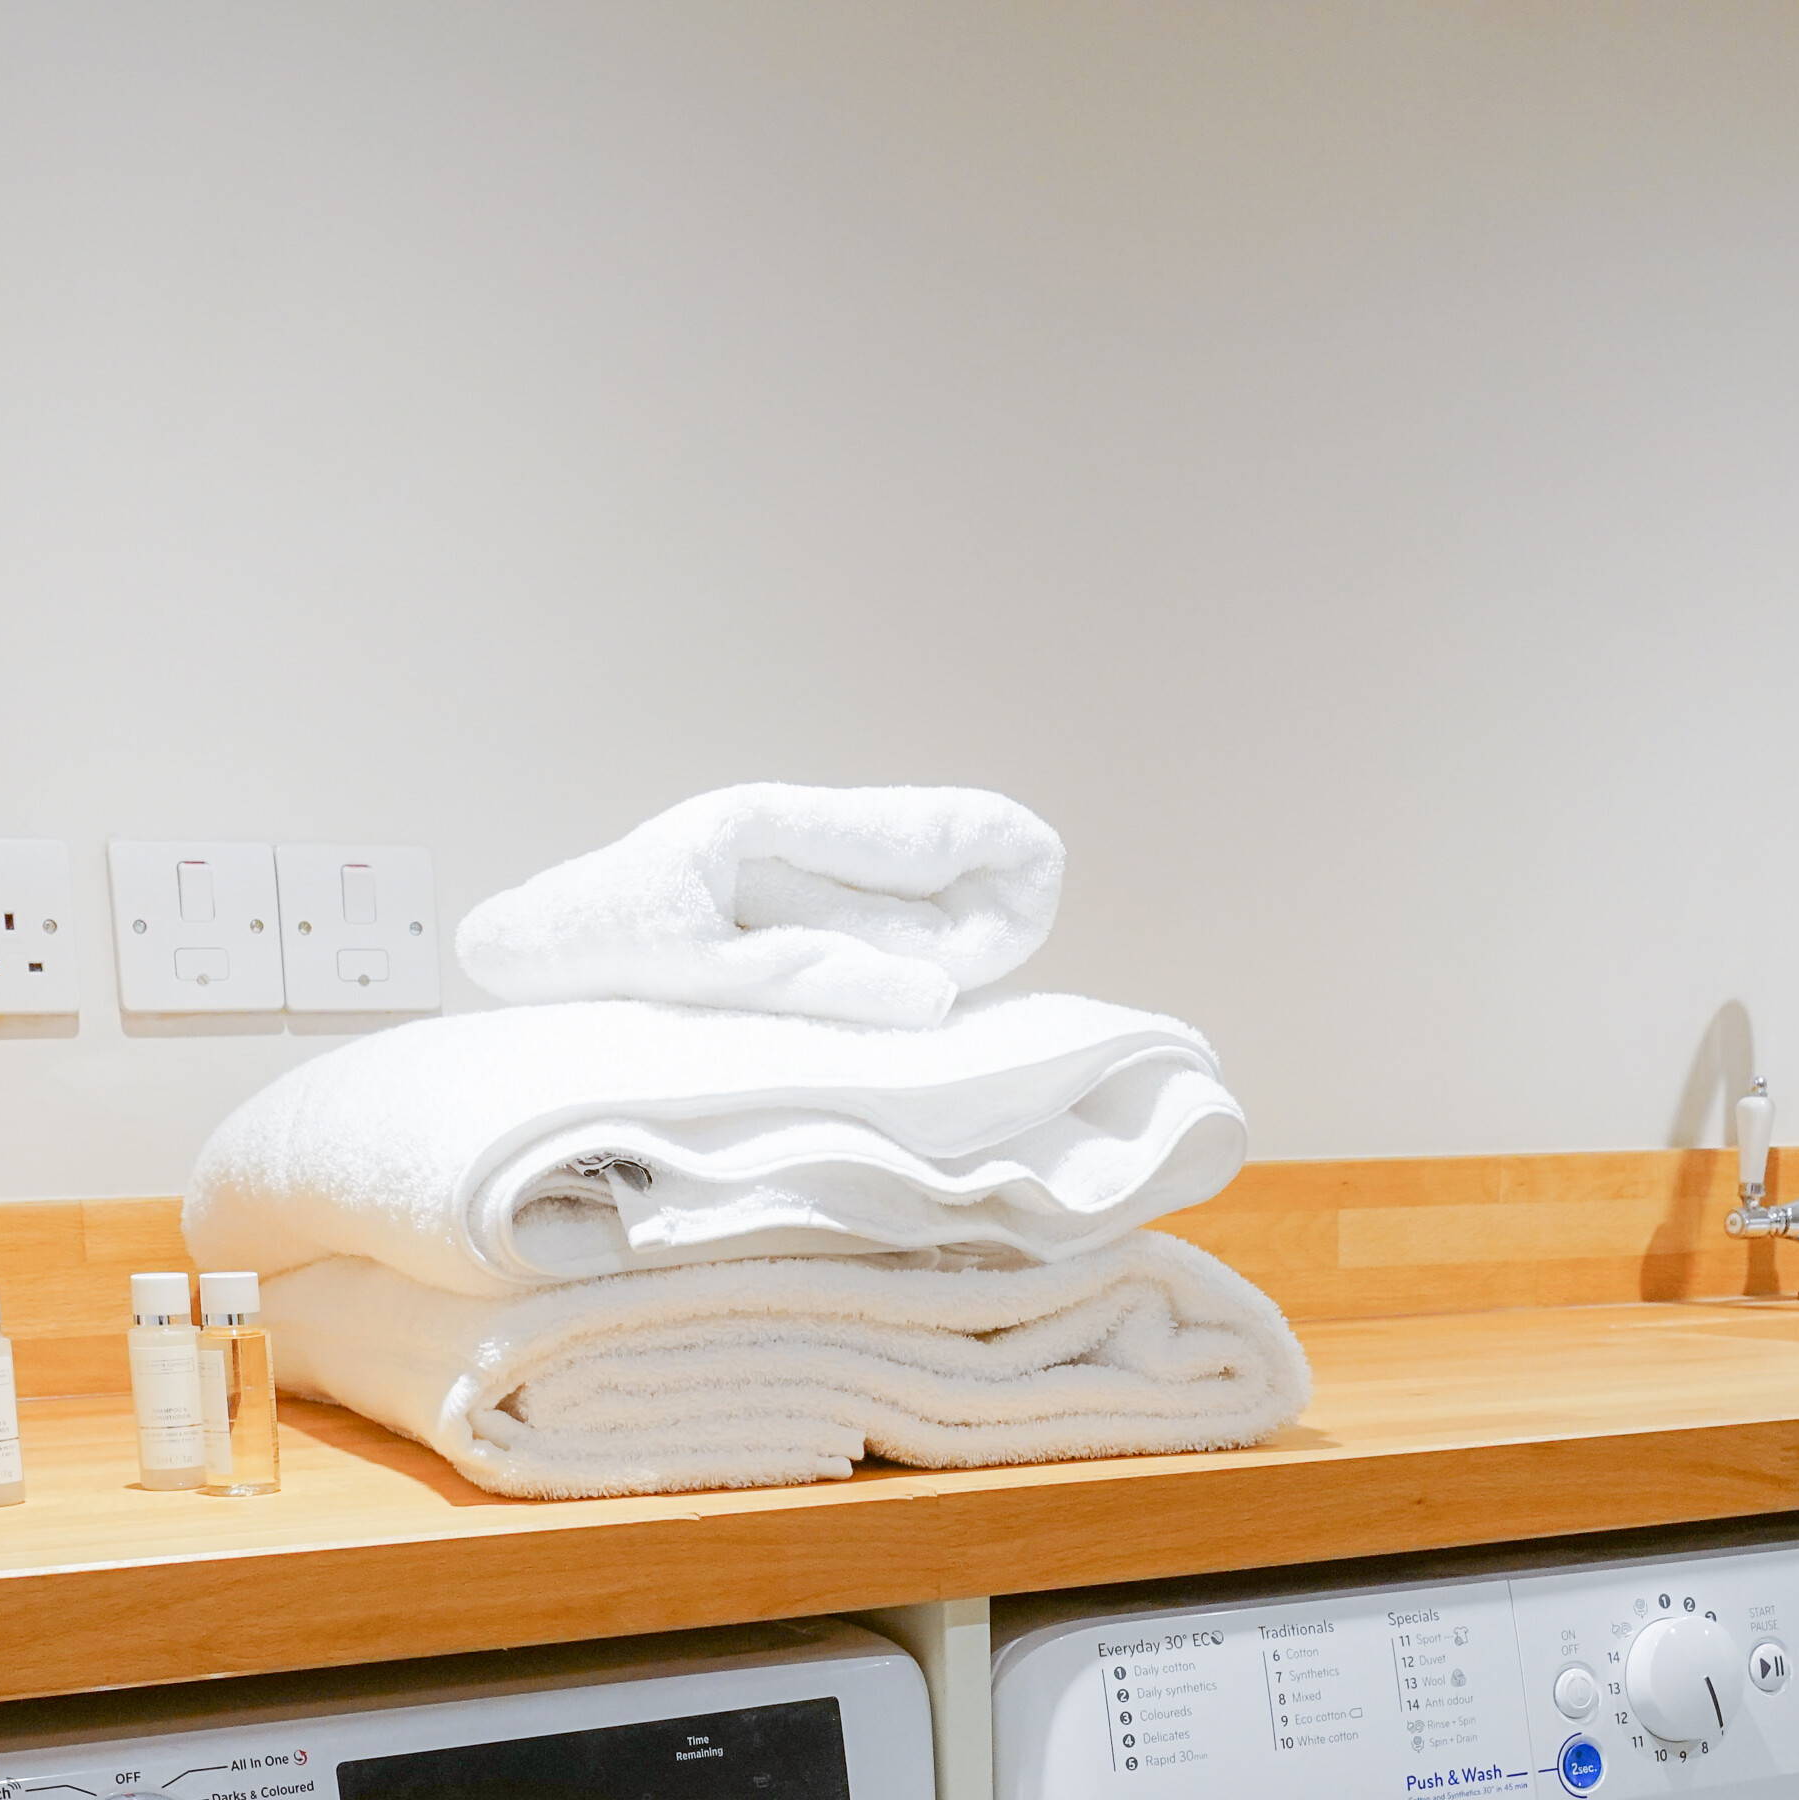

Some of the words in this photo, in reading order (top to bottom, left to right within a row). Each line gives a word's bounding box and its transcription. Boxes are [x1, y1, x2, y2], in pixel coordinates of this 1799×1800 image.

[1387, 1608, 1440, 1628] Specials
[1748, 1605, 1776, 1618] START
[1257, 1619, 1335, 1640] Traditionals
[1750, 1619, 1778, 1632] PAUSE
[1399, 1634, 1411, 1647] 11
[1416, 1632, 1442, 1646] Sport
[1561, 1629, 1576, 1641] ON
[1097, 1638, 1161, 1658] Everyday
[1164, 1633, 1187, 1651] 30°
[1561, 1643, 1580, 1656] OFF
[1272, 1649, 1280, 1662] 6
[1286, 1647, 1320, 1660] Cotton
[1401, 1655, 1415, 1669] 12
[1419, 1653, 1447, 1666] Duvet
[1607, 1651, 1621, 1664] 14
[1134, 1664, 1160, 1677] Daily
[1162, 1661, 1196, 1674] cotton
[1275, 1671, 1283, 1683] 7
[1289, 1667, 1340, 1683] Synthetics
[1404, 1677, 1418, 1690] 13
[1421, 1675, 1446, 1687] Wool
[1607, 1682, 1621, 1696] 13
[1137, 1686, 1162, 1700] Daily
[1165, 1682, 1218, 1697] synthetics
[1278, 1693, 1286, 1705] 8
[1292, 1690, 1322, 1703] Mixed
[1406, 1698, 1420, 1711] 14
[1425, 1697, 1444, 1709] Anti
[1447, 1694, 1474, 1706] odour
[1139, 1705, 1193, 1722] Coloureds
[1281, 1715, 1289, 1728] 9
[1294, 1713, 1313, 1725] Eco
[1315, 1711, 1347, 1723] cotton
[1615, 1711, 1629, 1725] 12
[1427, 1719, 1451, 1730] Rinse
[1457, 1716, 1477, 1728] Spin
[686, 1735, 710, 1747] Time
[1142, 1730, 1191, 1745] Delicates
[1280, 1736, 1294, 1750] 10
[1296, 1734, 1326, 1747] White
[1328, 1731, 1359, 1744] cotton
[1429, 1737, 1448, 1749] Spin
[1456, 1733, 1478, 1744] Drain
[1632, 1735, 1644, 1748] 11
[675, 1746, 724, 1761] Remaining
[1701, 1741, 1709, 1754] 8
[1145, 1753, 1176, 1768] Rapid
[1654, 1749, 1668, 1762] 10
[1679, 1750, 1687, 1763] 9
[231, 1758, 247, 1772] All
[250, 1758, 262, 1769] In
[264, 1755, 289, 1767] One
[115, 1771, 142, 1785] OFF
[1406, 1772, 1444, 1791] Push
[1447, 1769, 1461, 1786] &
[1461, 1763, 1503, 1783] Wash
[250, 1790, 258, 1800] &
[260, 1780, 315, 1798] Coloured
[1446, 1789, 1481, 1800] Synthetics
